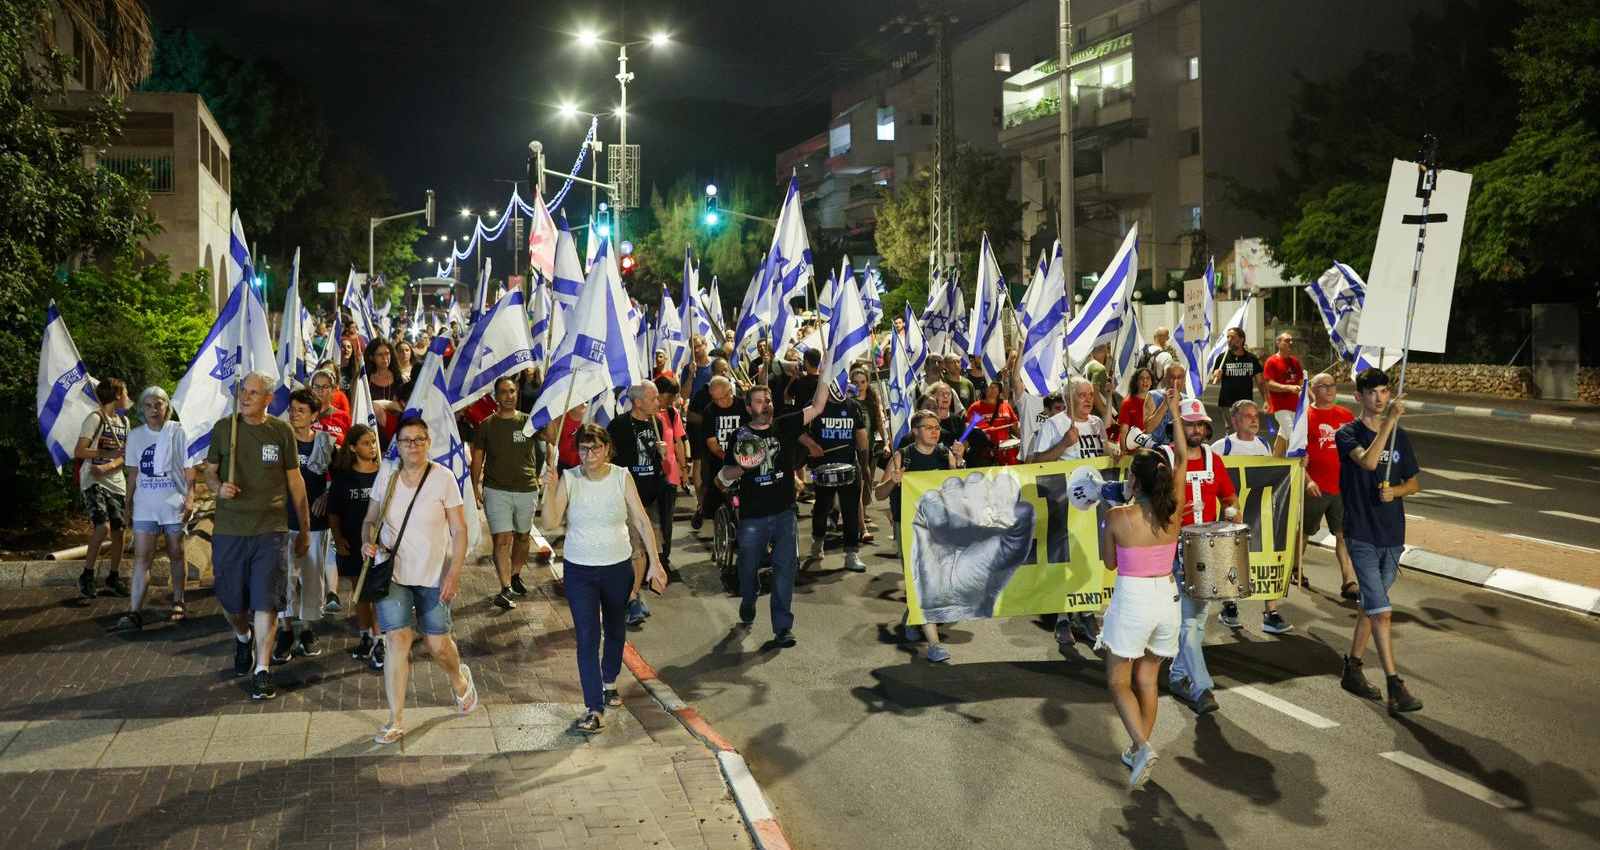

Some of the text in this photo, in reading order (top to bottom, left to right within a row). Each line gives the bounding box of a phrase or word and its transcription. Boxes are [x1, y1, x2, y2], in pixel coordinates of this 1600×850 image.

[719, 416, 740, 429] דמו
[821, 418, 854, 429] חופשי
[822, 429, 853, 439] בארצנו
[1079, 434, 1104, 448] דמו
